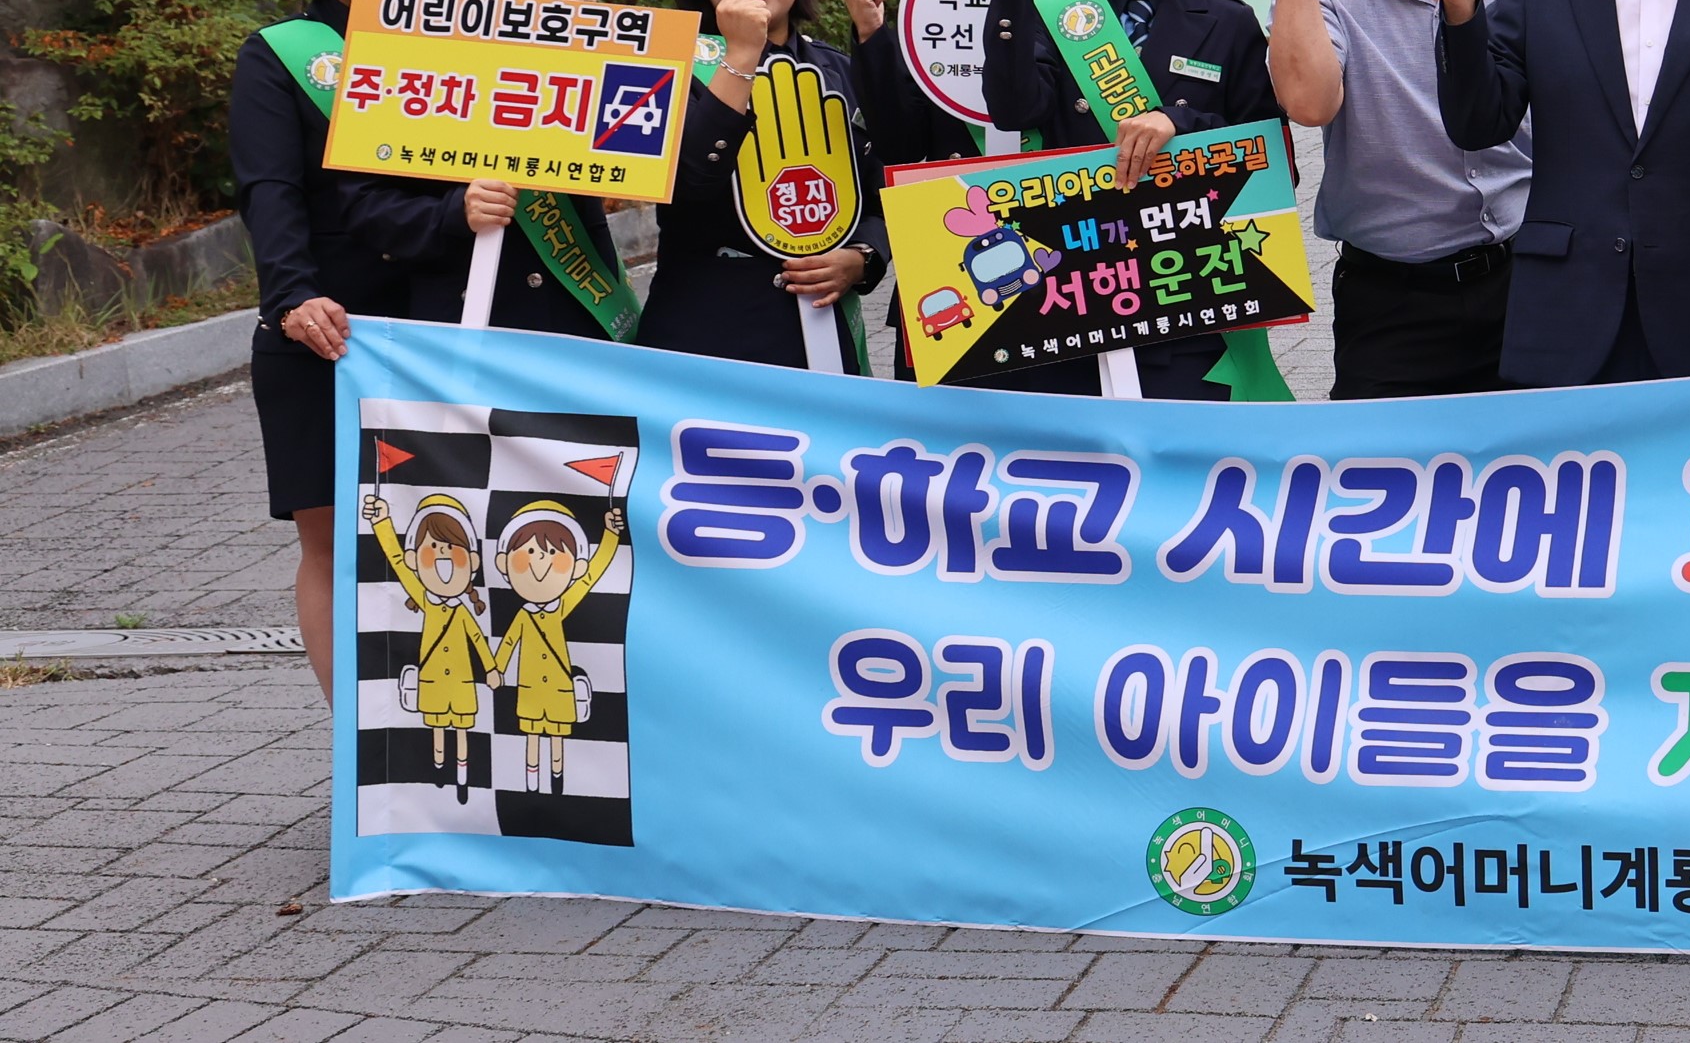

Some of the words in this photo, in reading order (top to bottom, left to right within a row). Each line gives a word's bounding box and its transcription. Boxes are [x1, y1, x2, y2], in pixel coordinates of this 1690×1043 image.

[922, 22, 974, 50] 우선
[491, 70, 595, 133] 금지
[399, 145, 627, 184] 녹색어머니계룡시연합회
[777, 202, 832, 226] STOP
[1060, 217, 1130, 253] 내가
[1138, 196, 1214, 243] 먼저
[1020, 299, 1260, 360] 녹색어머니계룡시연합회
[664, 424, 1134, 578] 등·하교
[1162, 457, 1621, 591] 시간에
[828, 635, 1049, 764] 우리
[1100, 649, 1603, 786] 아이들을
